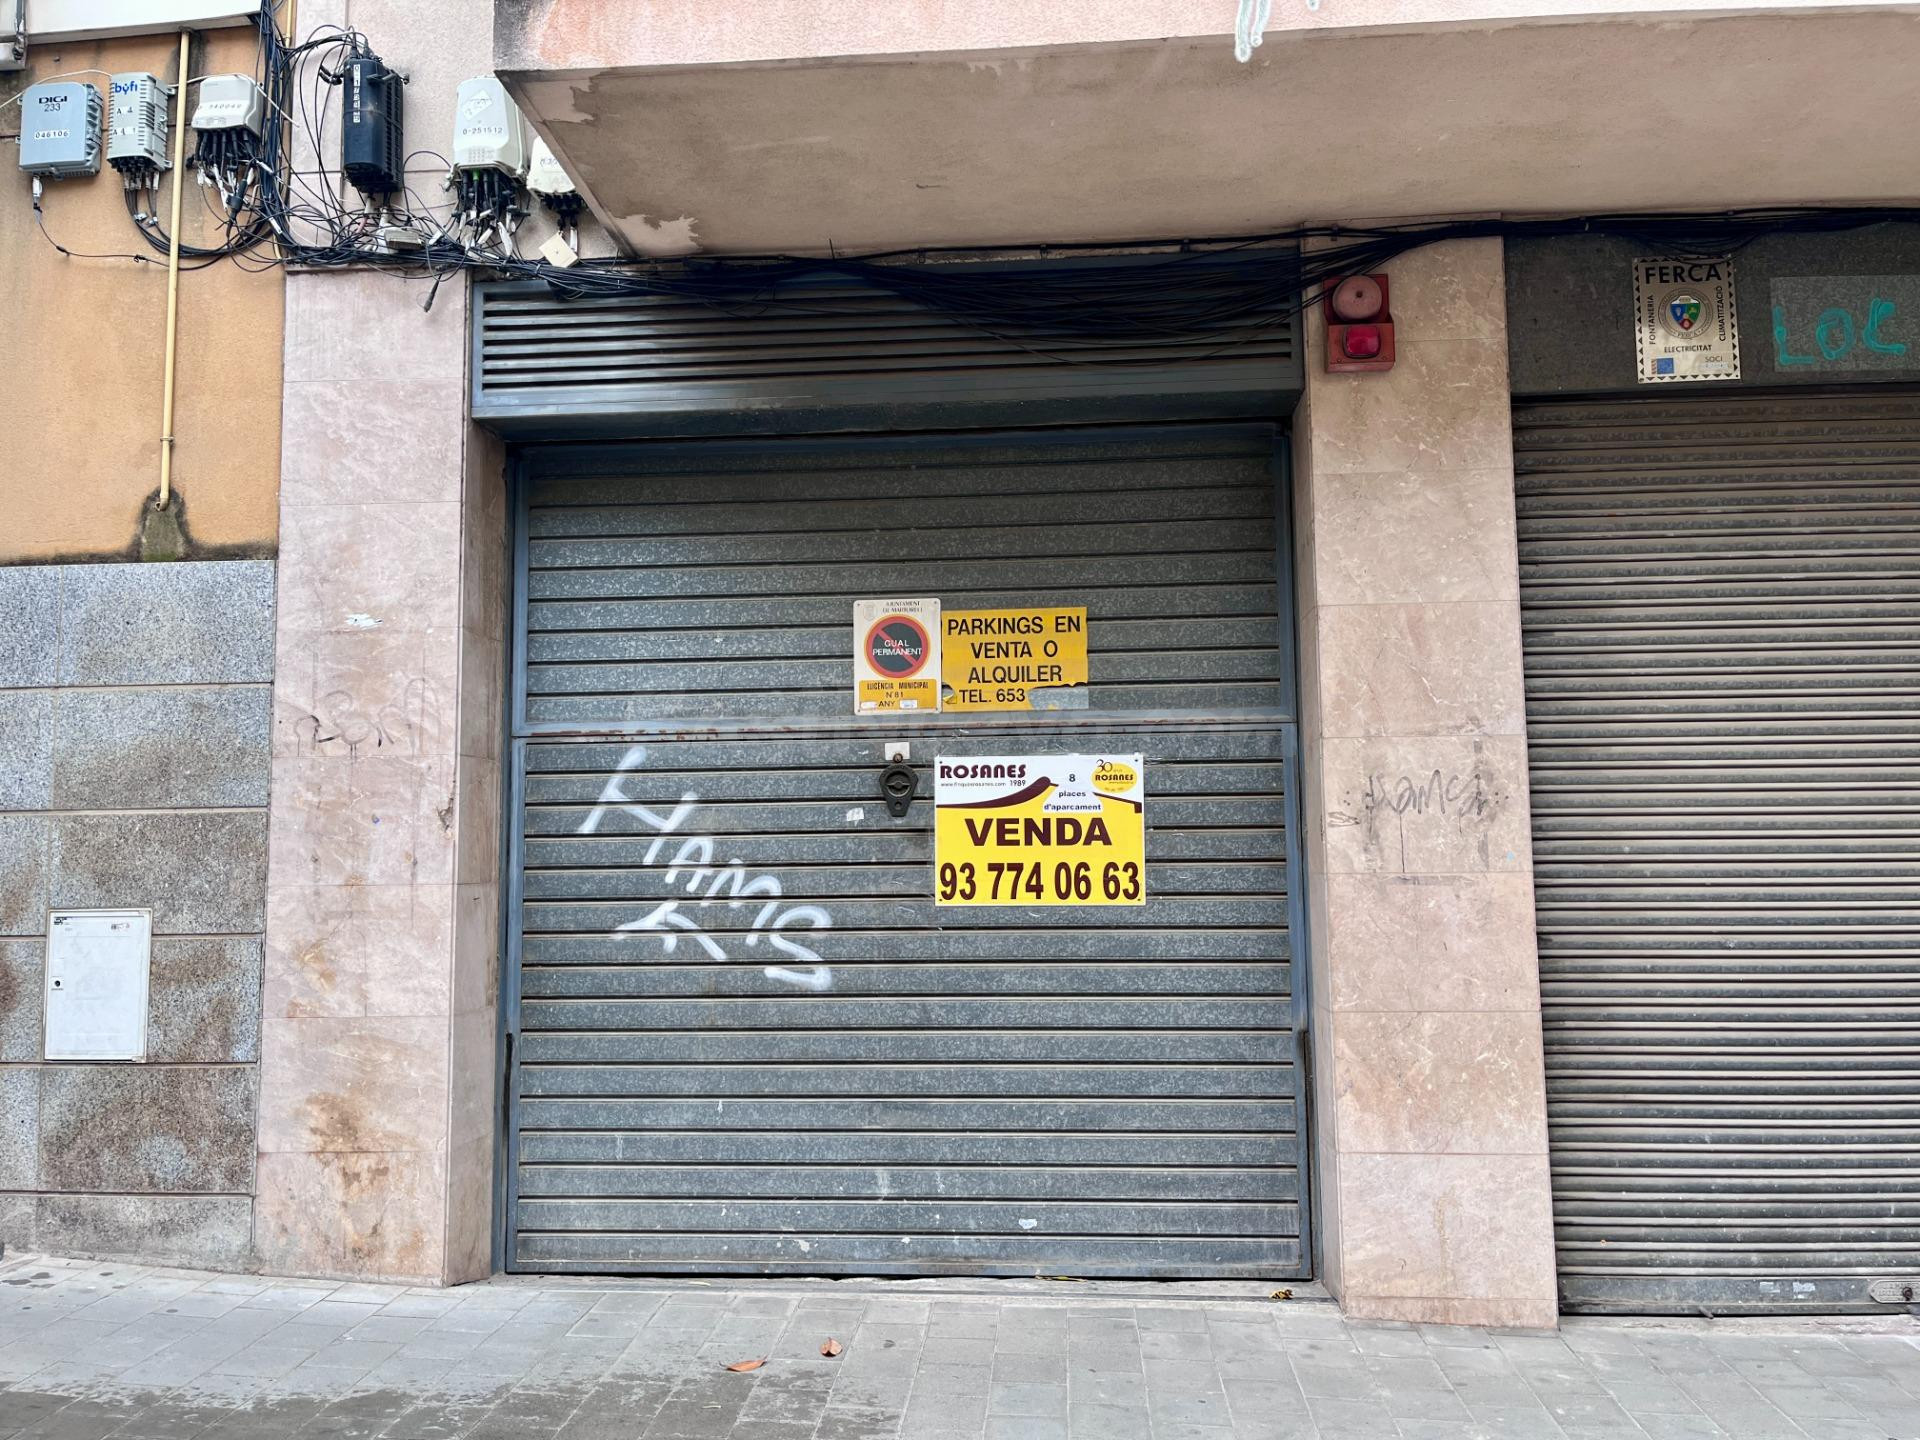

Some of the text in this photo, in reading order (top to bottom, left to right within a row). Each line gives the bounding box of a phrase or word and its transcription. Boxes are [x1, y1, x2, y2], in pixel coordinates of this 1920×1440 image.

[39, 95, 68, 104] DIGI
[44, 103, 61, 112] 233
[1645, 265, 1722, 285] FERCA
[1664, 344, 1713, 354] ELECTRICITAT
[947, 615, 1081, 636] PARKINGS EN
[872, 647, 922, 656] PERMANENT
[971, 640, 1059, 660] VENTA O
[968, 665, 1062, 684] ALQUILER
[898, 681, 929, 690] MUNICIPAL
[959, 688, 1026, 703] TEL. 653
[878, 700, 896, 708] ANY
[1096, 758, 1113, 774] 30
[940, 764, 1026, 779] ROSANES
[1069, 773, 1076, 783] 8
[1095, 774, 1134, 782] ROSANES
[1009, 779, 1026, 788] 1989
[1058, 790, 1087, 798] places
[1043, 803, 1102, 812] d'aparcament
[964, 817, 1113, 848] VENDA
[939, 861, 1141, 900] 93 774 06 63
